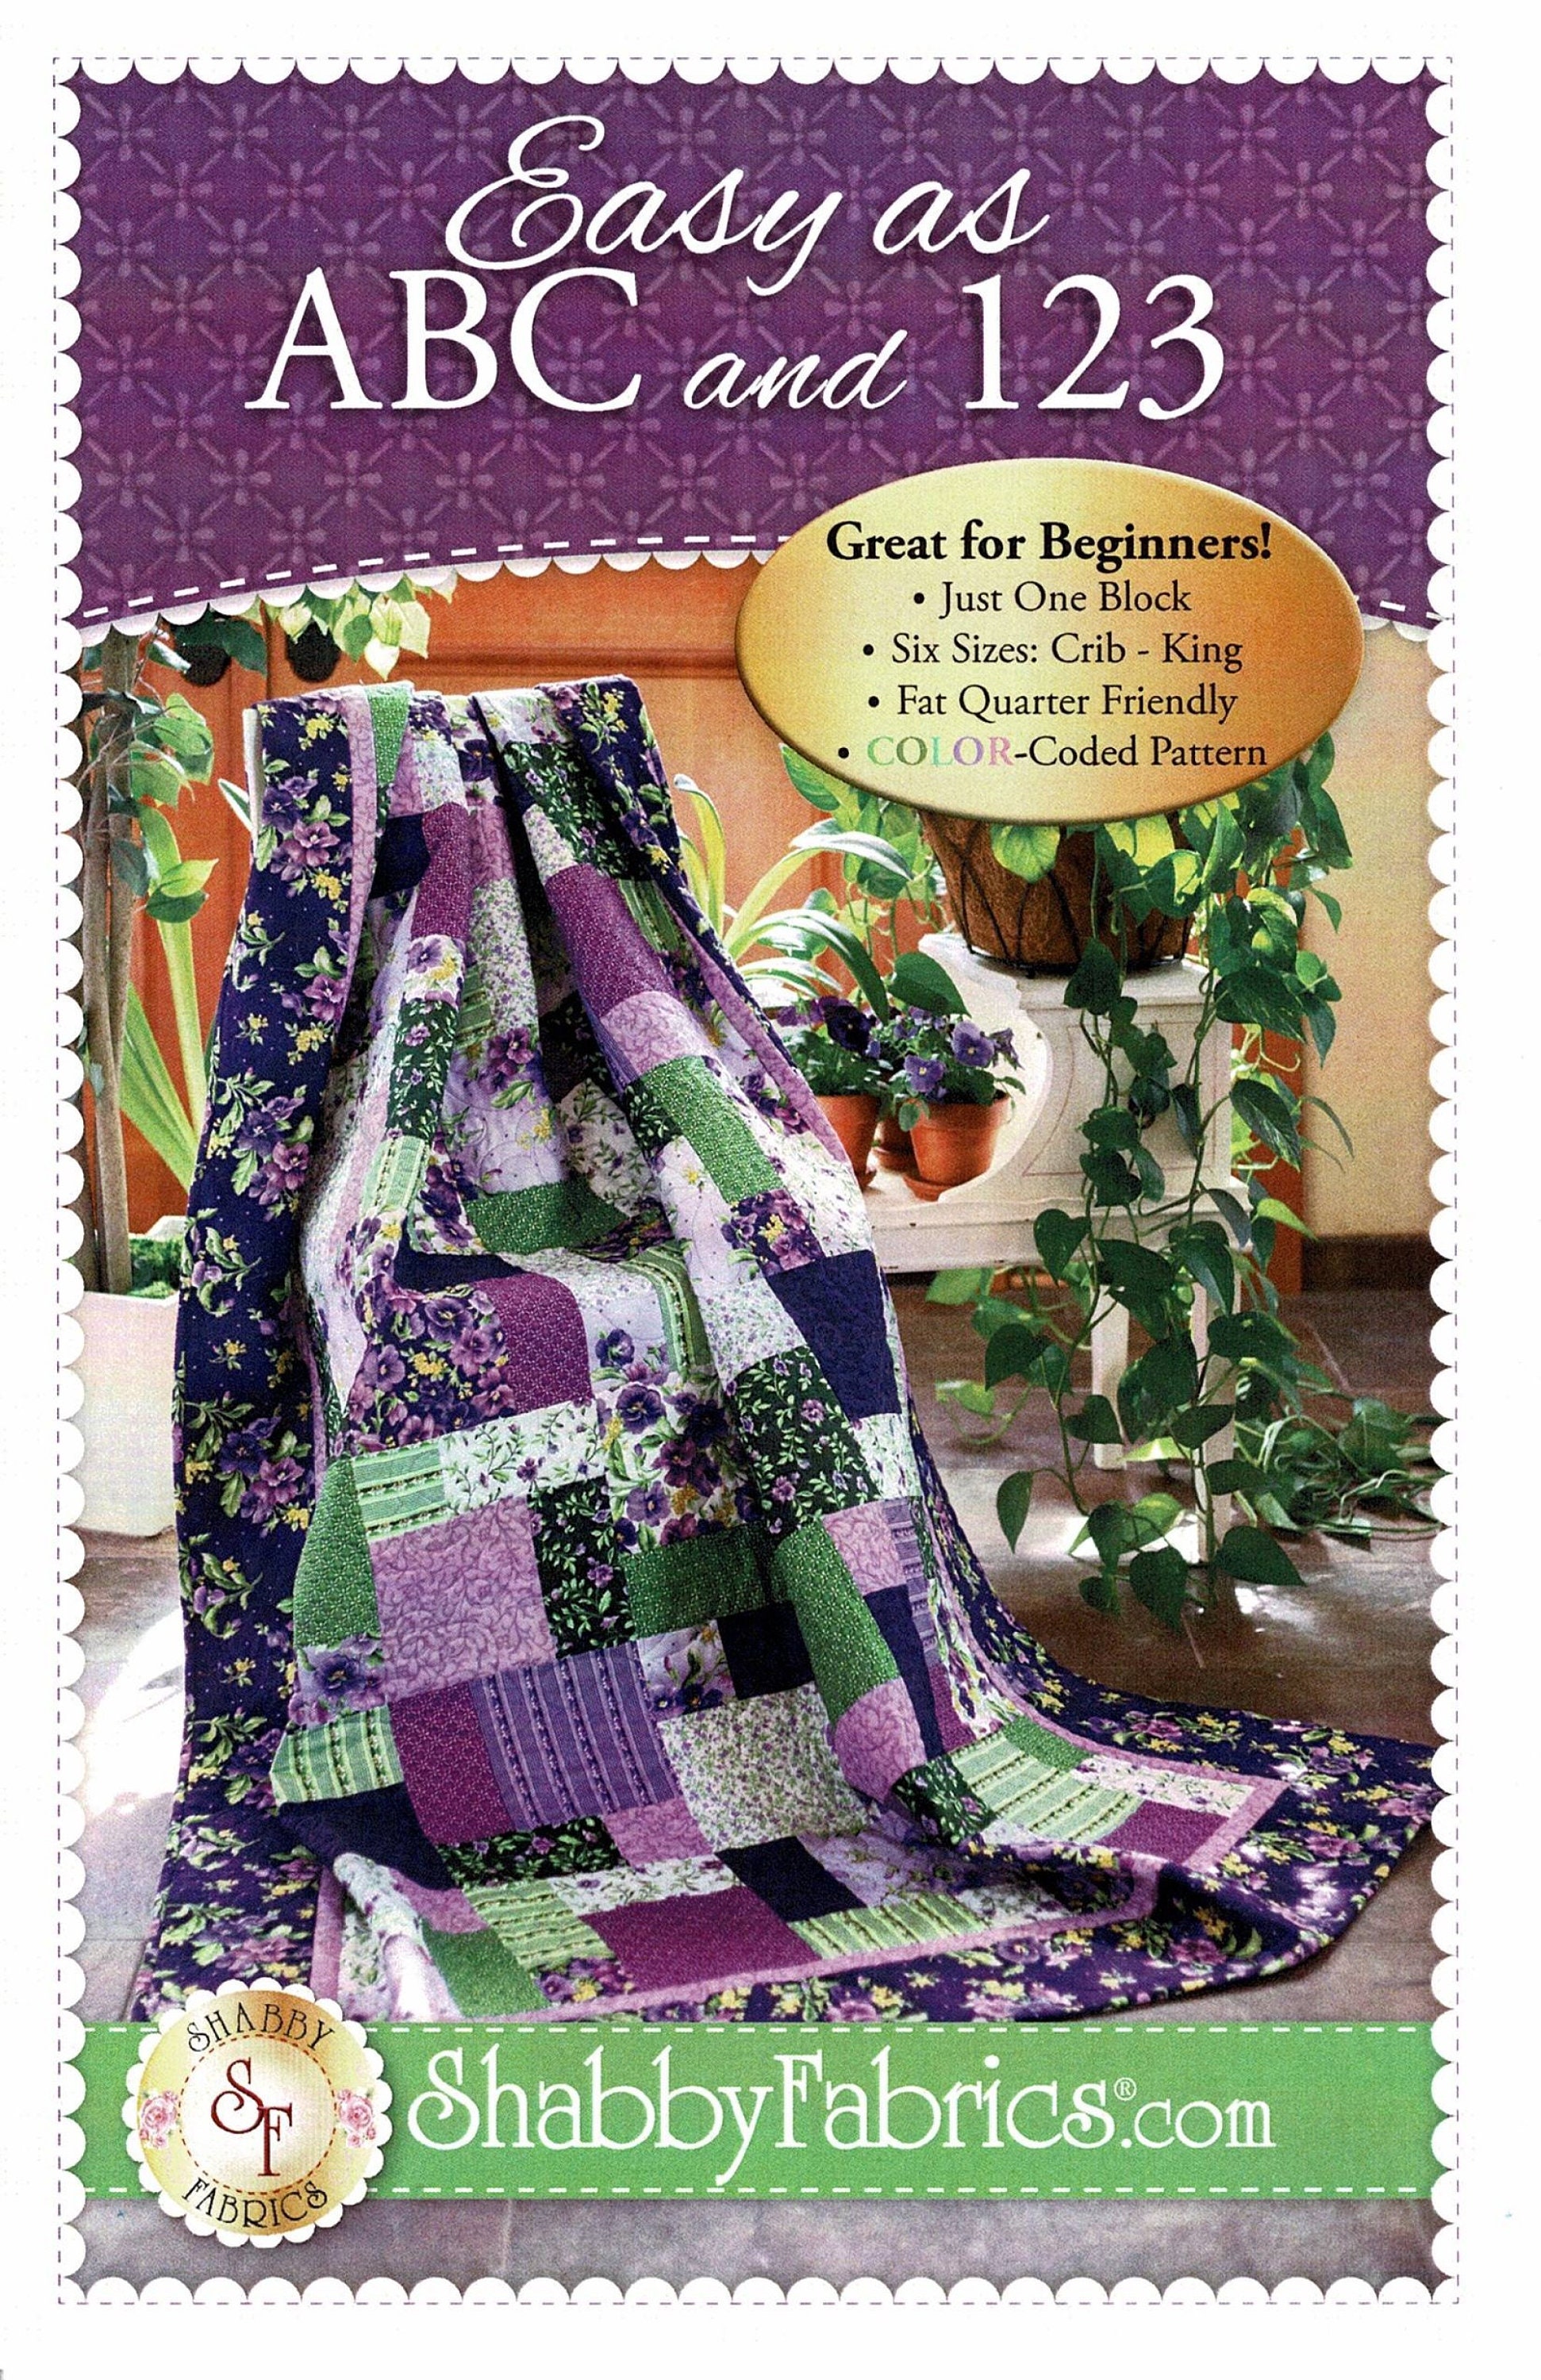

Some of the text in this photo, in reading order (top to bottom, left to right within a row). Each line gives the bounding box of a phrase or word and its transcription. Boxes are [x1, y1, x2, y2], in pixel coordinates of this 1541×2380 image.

[444, 116, 1051, 297] Easy as
[244, 267, 1224, 420] ABC and 123
[826, 518, 1272, 574] Great for Beginners!
[939, 579, 1193, 620] Just One Block
[892, 632, 940, 663] Six
[951, 632, 1038, 663] Sizes:
[1051, 631, 1127, 663] Crib
[1162, 632, 1244, 674] King
[897, 682, 1239, 726] Fat Quarter Friendly
[867, 735, 1268, 767] COLOR-Coded Pattern
[187, 2002, 335, 2052] SHABBY
[182, 2178, 329, 2228] FABRICS
